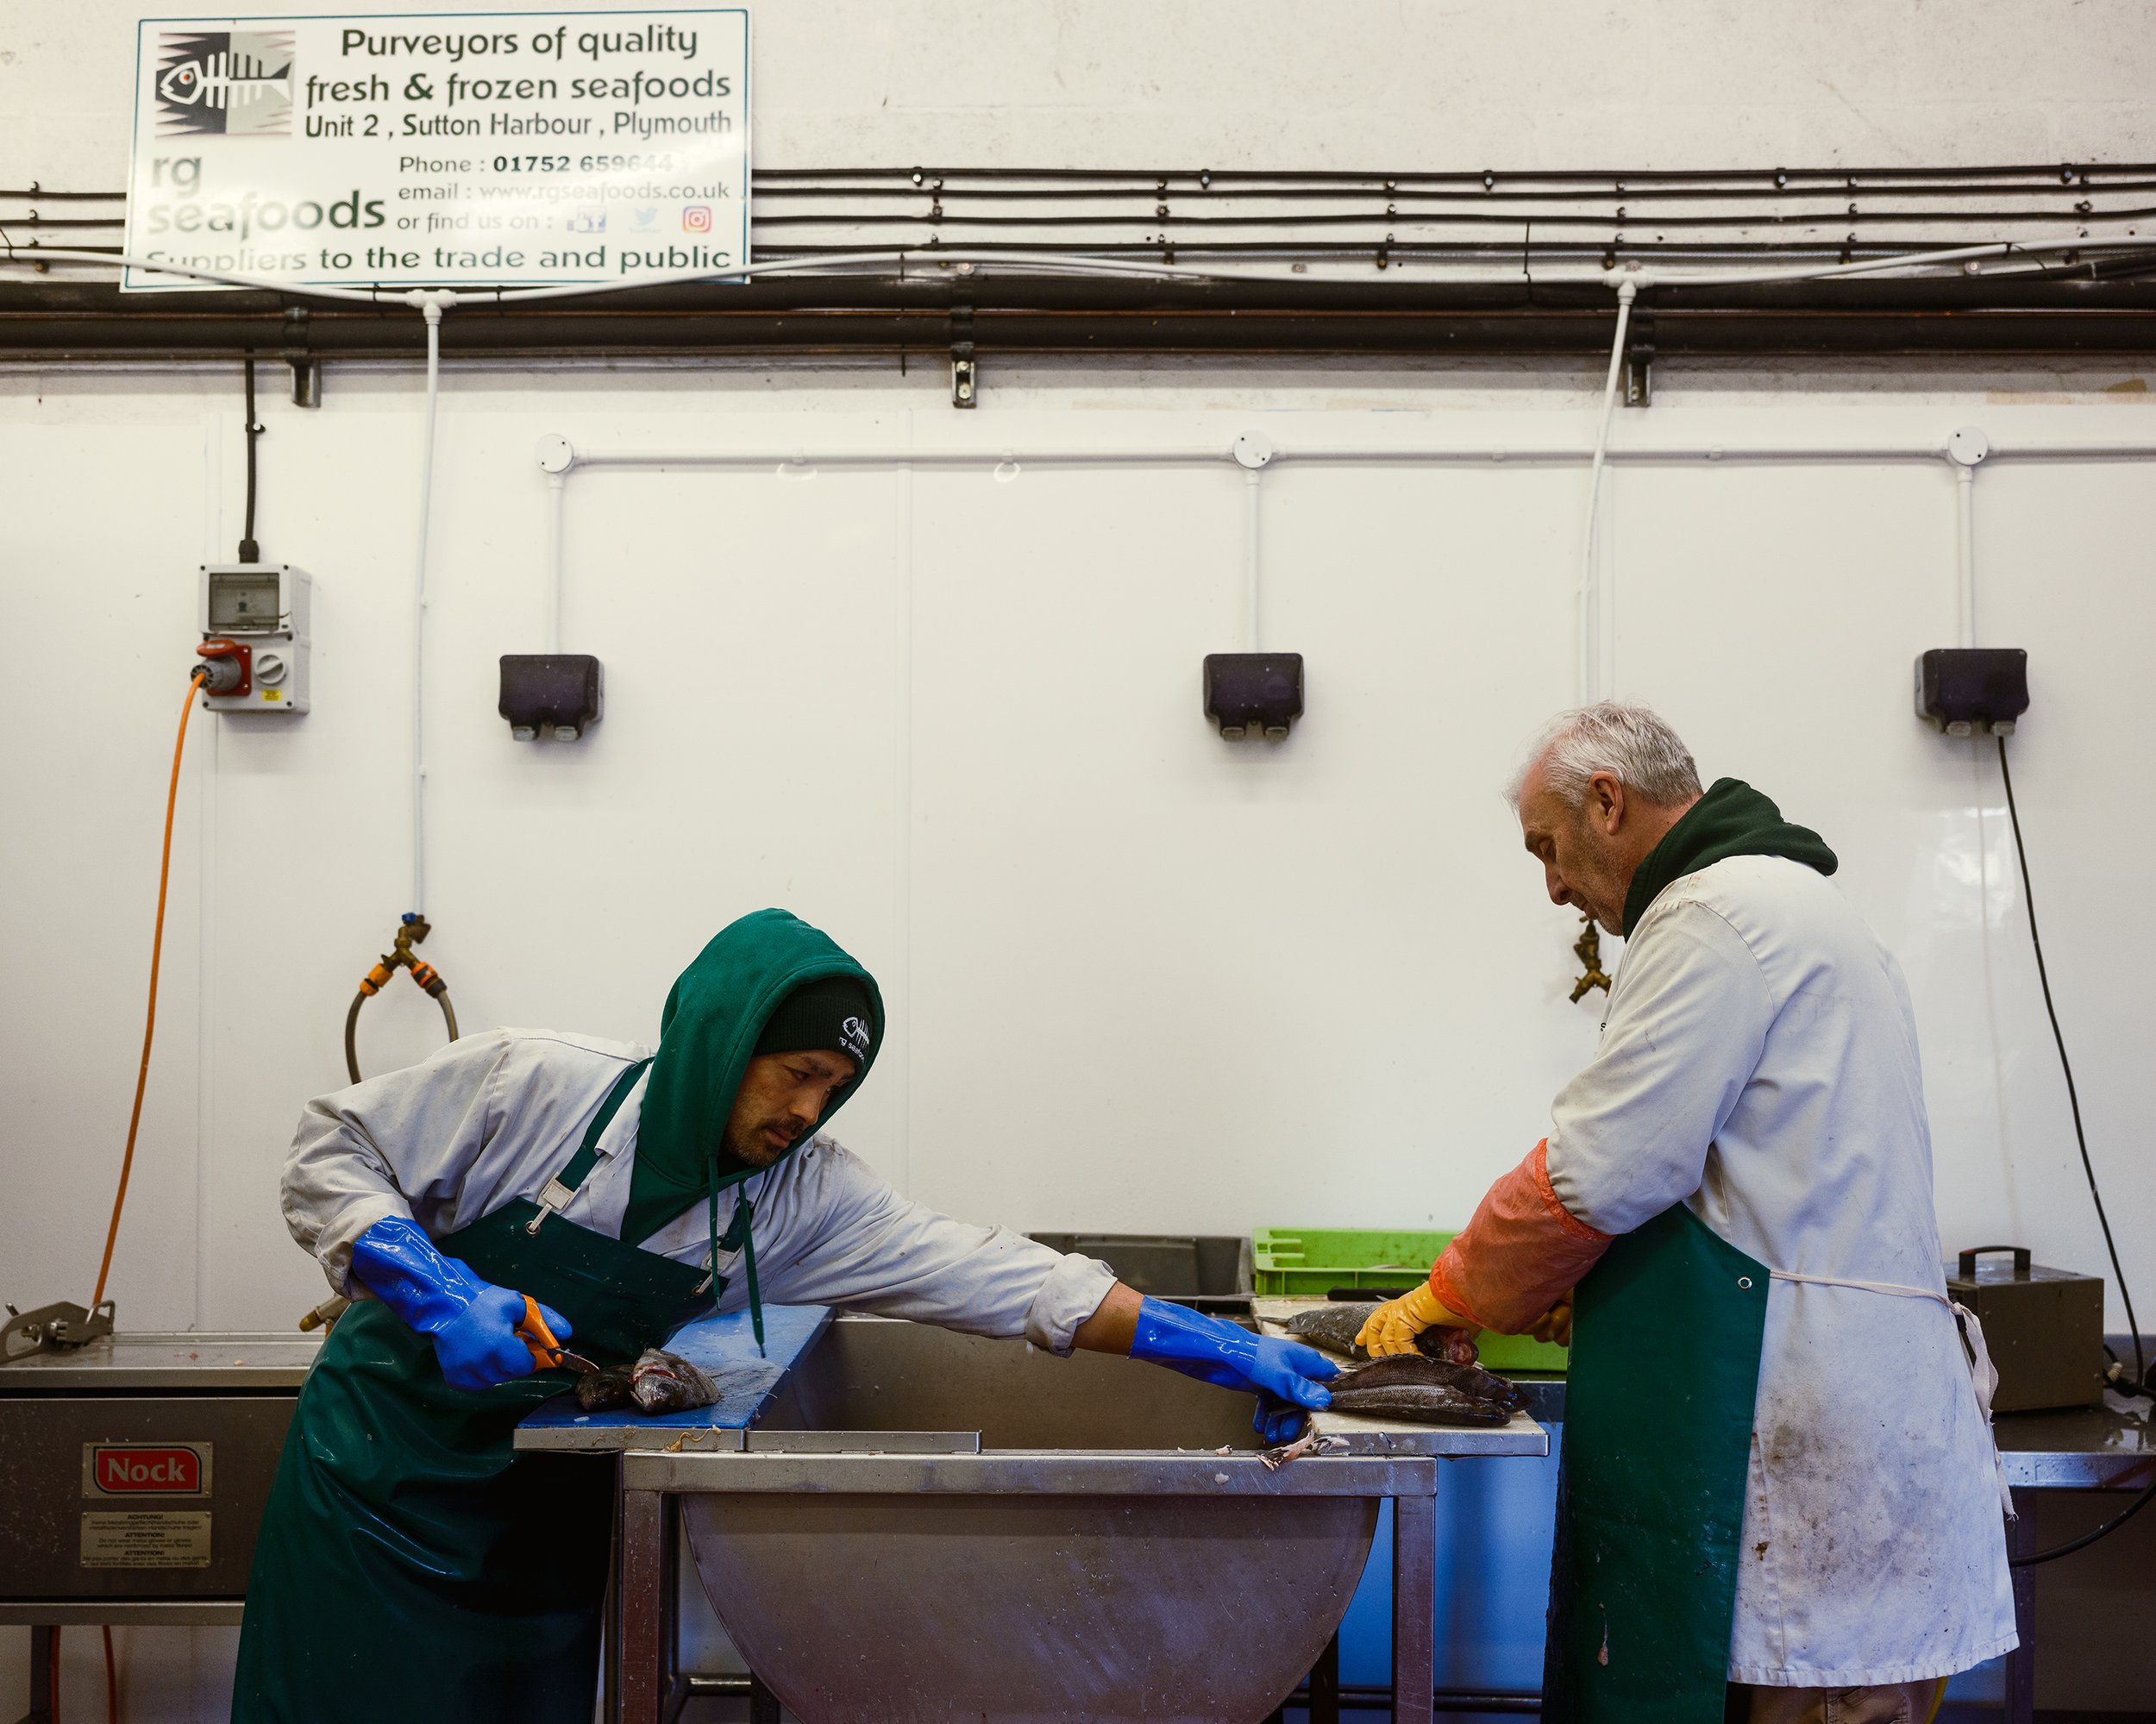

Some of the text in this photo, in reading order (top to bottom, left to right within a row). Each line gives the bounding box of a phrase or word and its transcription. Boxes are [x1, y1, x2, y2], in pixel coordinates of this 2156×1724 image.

[342, 24, 698, 63] Purveyors of quality
[305, 69, 731, 110] fresh & frozen seafoods
[305, 114, 354, 138] Unit
[402, 113, 481, 137] Sutton
[490, 112, 592, 136] Harbour
[613, 110, 731, 141] Plymouth
[399, 155, 473, 173] Phone
[492, 155, 571, 172] 01752
[580, 154, 674, 172] 659644
[146, 156, 386, 241] rg seafoods
[398, 182, 459, 201] email
[479, 181, 730, 204] www.rgseafoods.co.uk
[397, 216, 421, 230] or
[426, 212, 469, 234] find
[477, 216, 503, 230] us
[509, 215, 539, 230] on
[320, 248, 353, 269] to
[366, 246, 421, 268] the
[433, 245, 526, 268] trade
[539, 245, 606, 268] and
[619, 245, 731, 275] public
[107, 1457, 186, 1483] Nock
